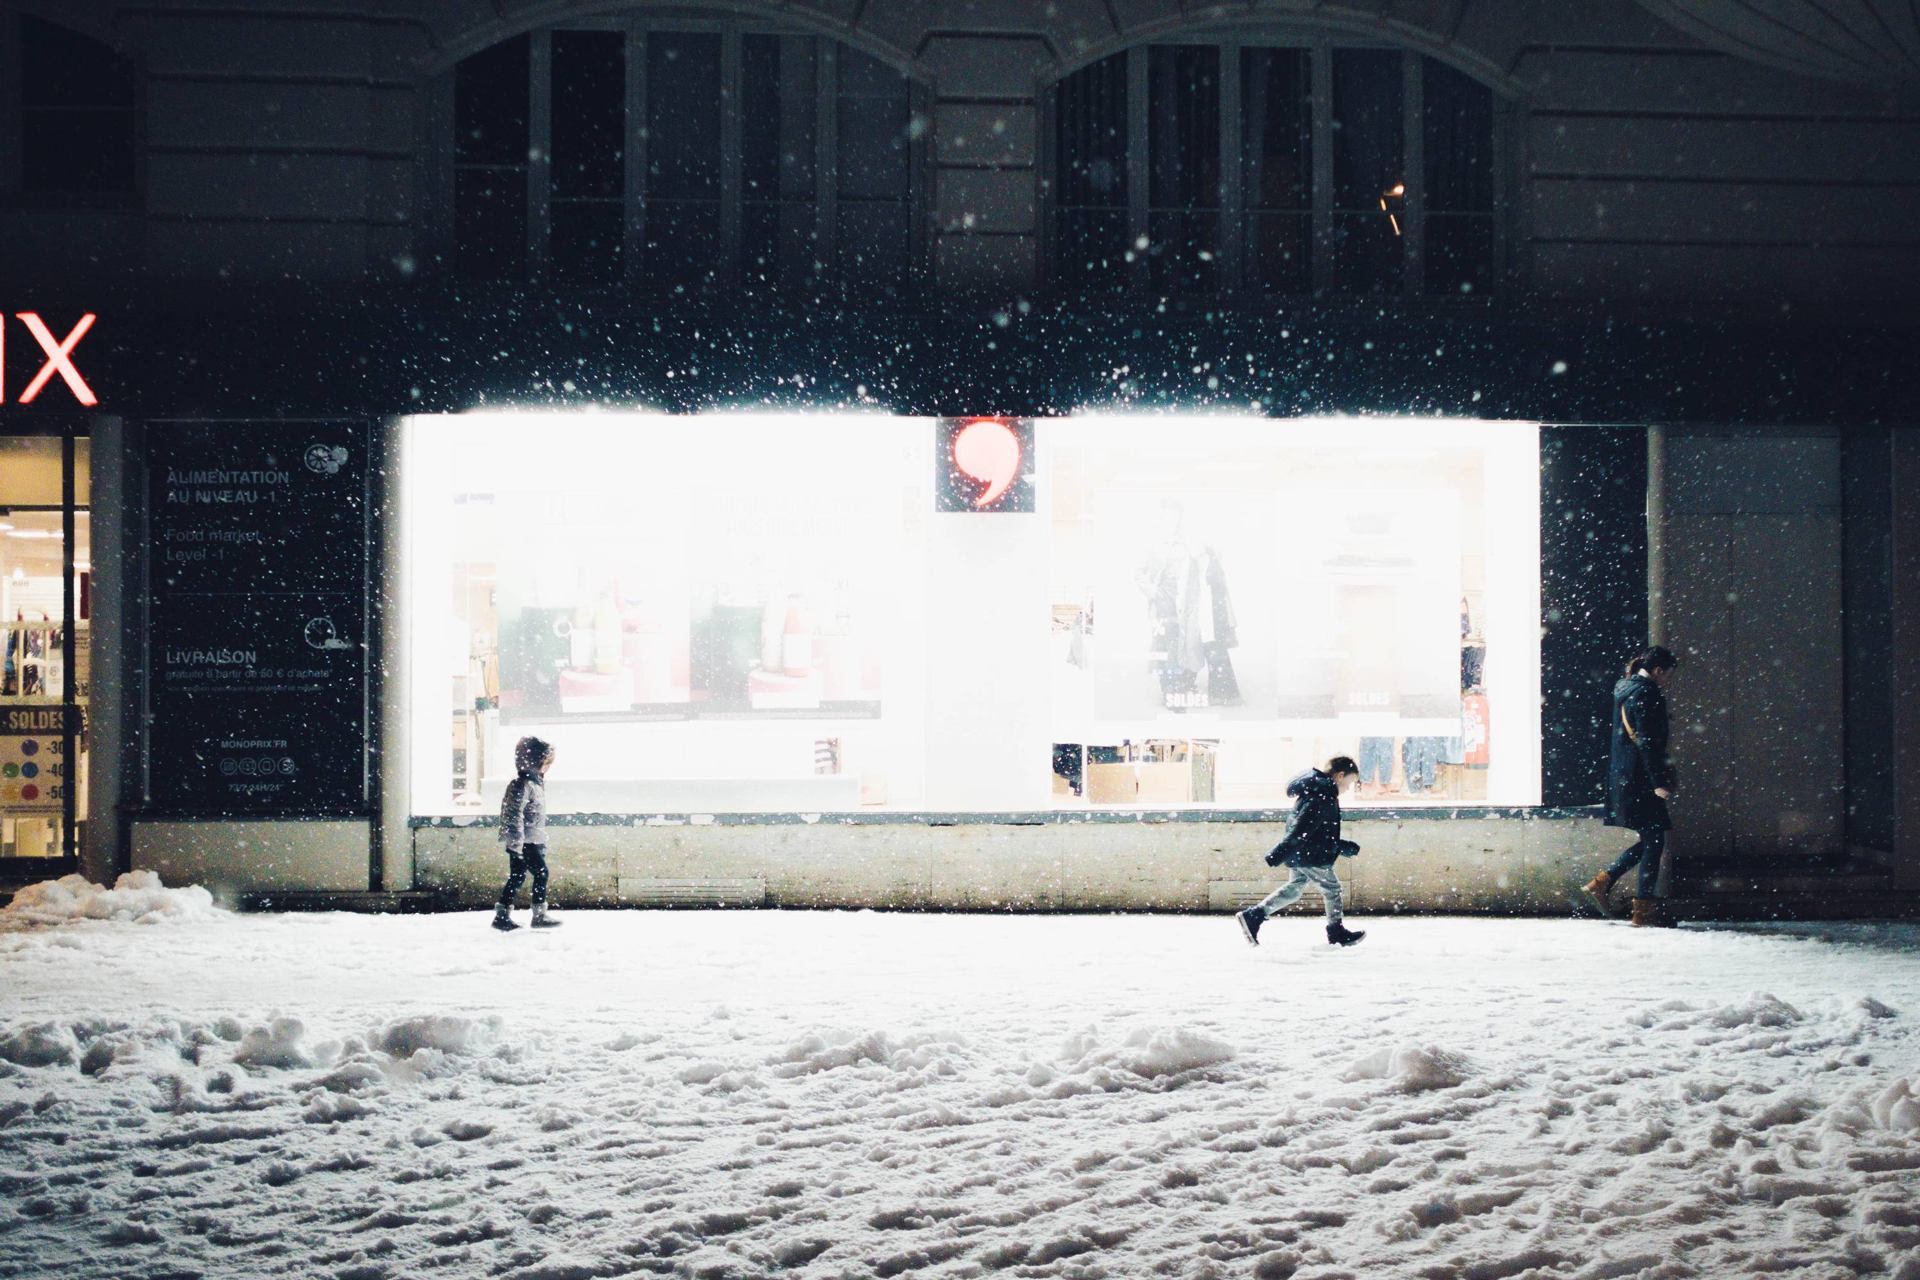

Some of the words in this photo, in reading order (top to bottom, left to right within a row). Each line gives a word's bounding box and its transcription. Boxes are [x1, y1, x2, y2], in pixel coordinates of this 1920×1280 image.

[166, 470, 289, 484] ALIMENTATION
[166, 490, 190, 503] AU
[195, 490, 257, 503] NIVEAU
[262, 490, 276, 503] -1
[166, 528, 204, 542] Food
[208, 528, 260, 542] market
[166, 548, 207, 561] Level
[211, 548, 225, 561] -1
[166, 650, 257, 664] LIVRAISON
[1166, 692, 1209, 708] SOLDES
[8, 711, 64, 730] SOLDES
